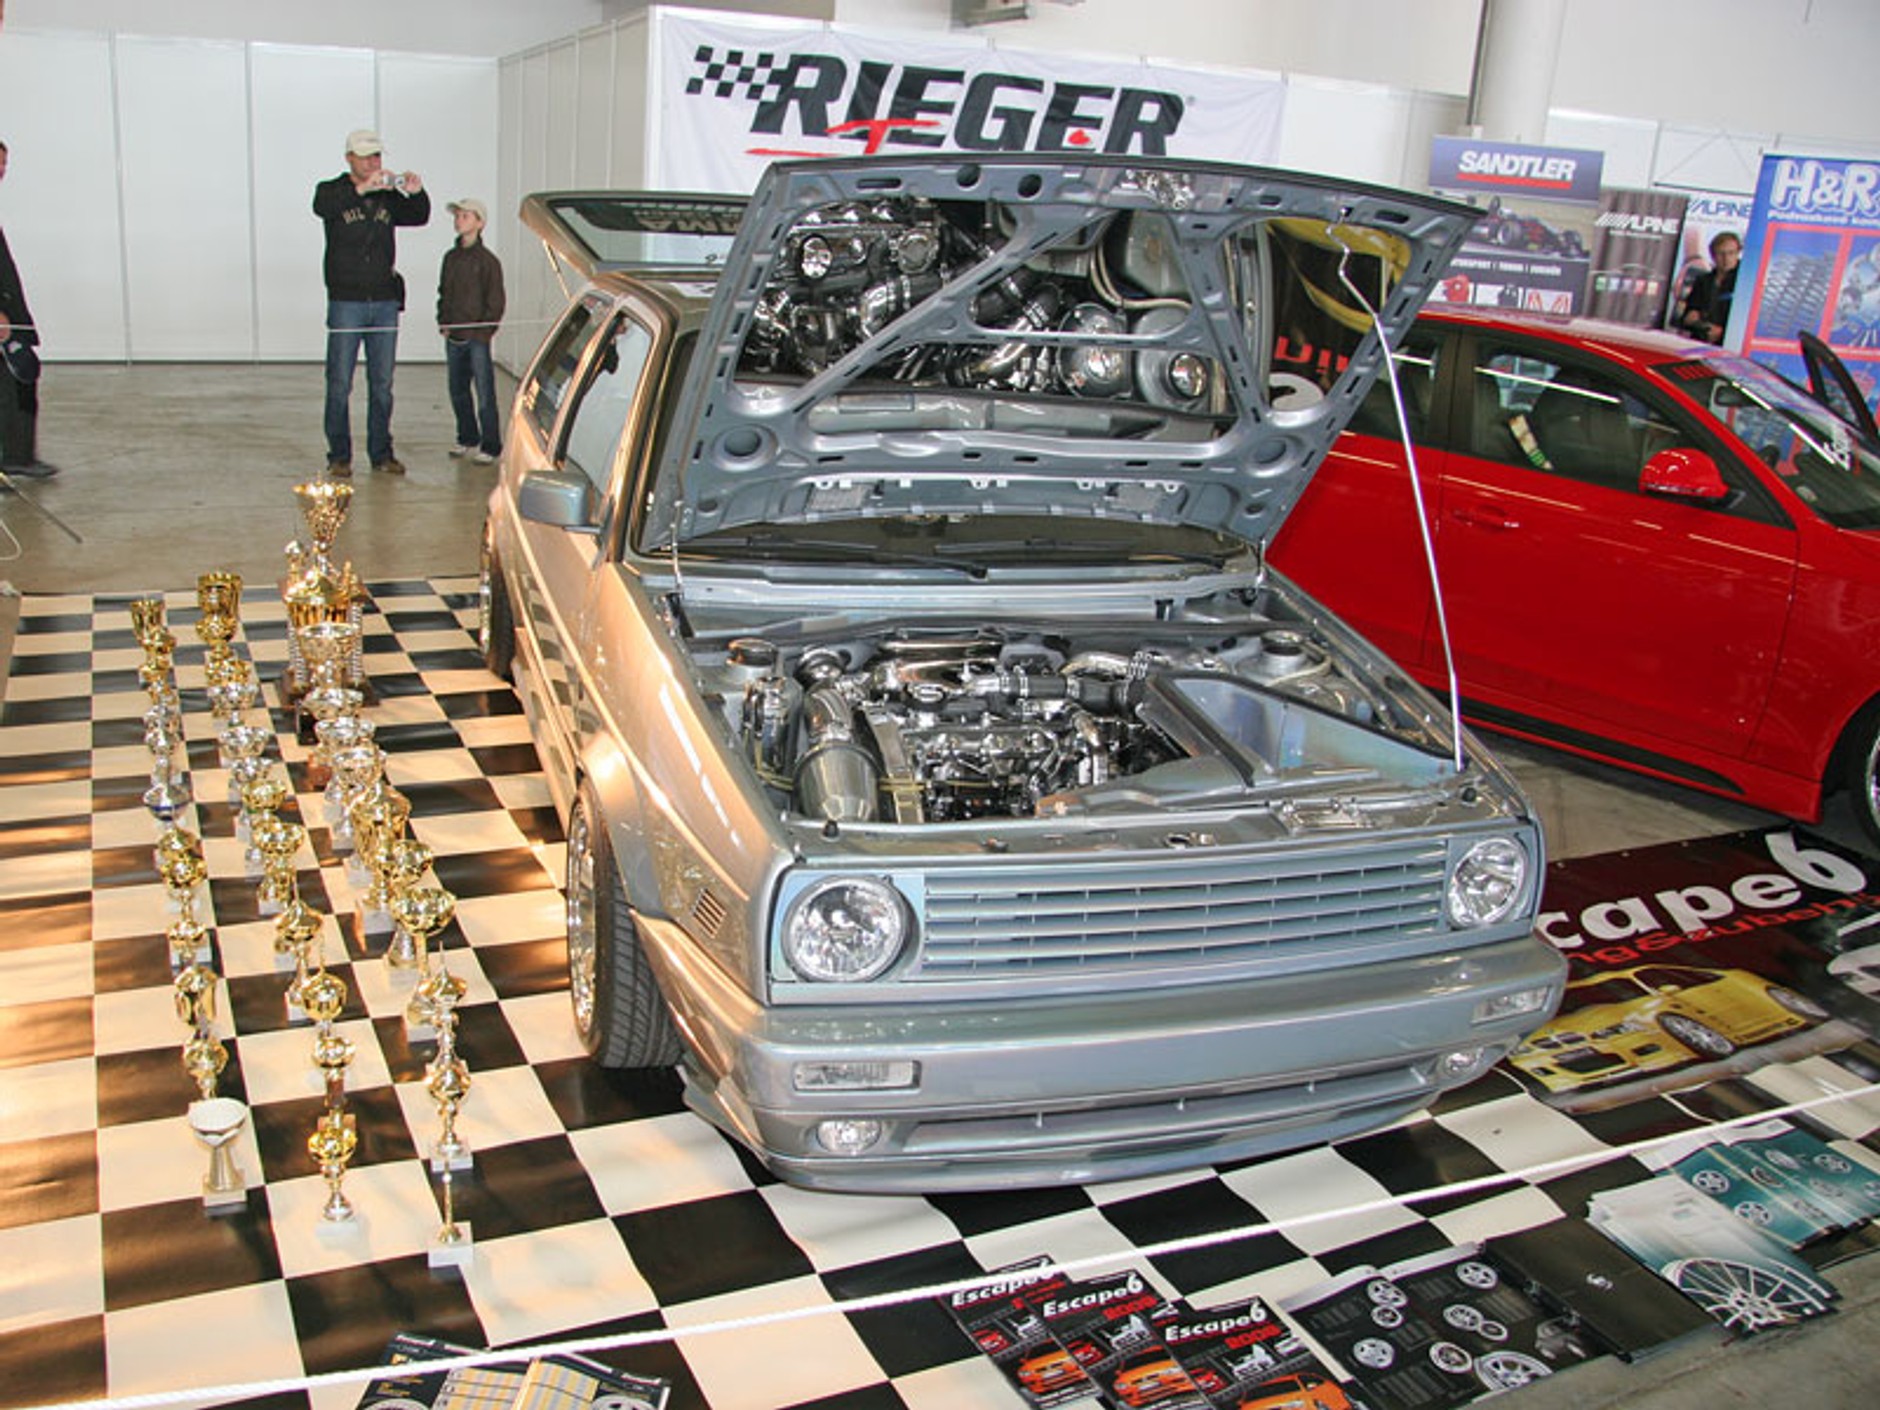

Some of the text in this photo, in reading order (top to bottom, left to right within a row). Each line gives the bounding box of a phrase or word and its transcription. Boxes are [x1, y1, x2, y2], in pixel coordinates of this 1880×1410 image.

[749, 53, 1185, 157] RIEGER
[1458, 150, 1577, 181] SANDTLER
[1771, 160, 1880, 217] H&R
[1602, 211, 1680, 235] ALPINE
[1536, 831, 1868, 949] cape6
[1043, 1272, 1144, 1318] Escape6
[1165, 1301, 1268, 1341] Escape6
